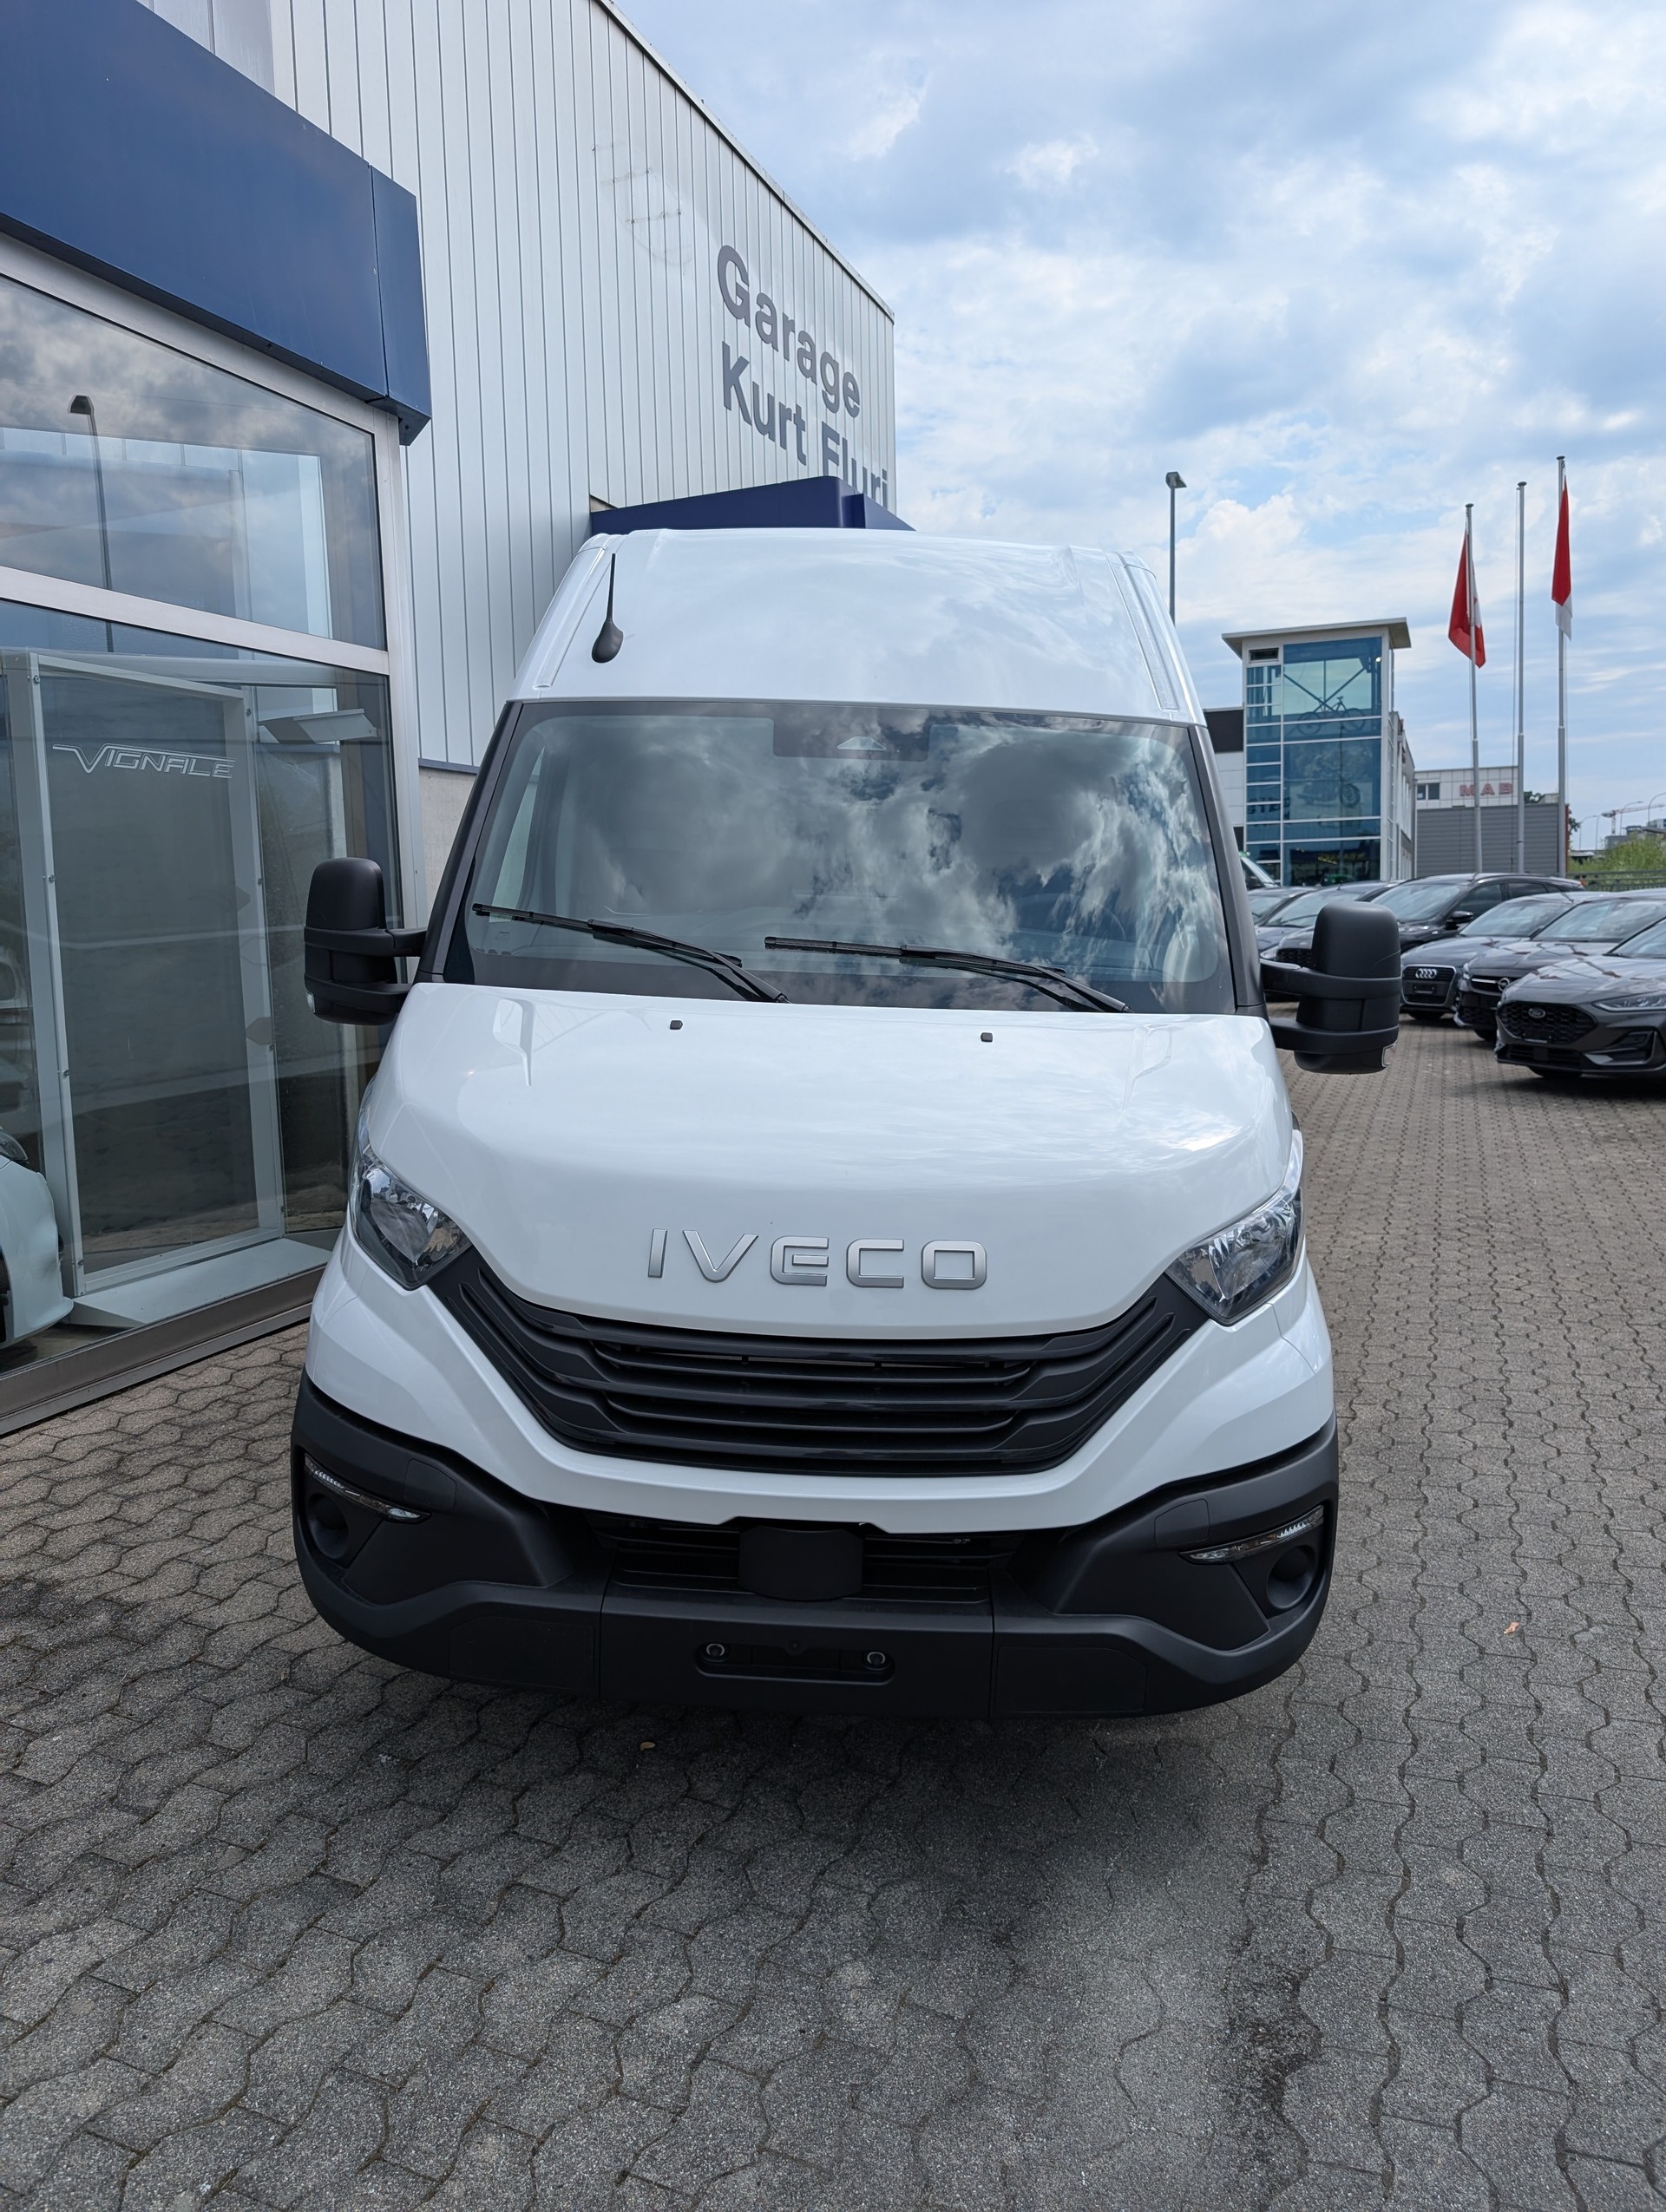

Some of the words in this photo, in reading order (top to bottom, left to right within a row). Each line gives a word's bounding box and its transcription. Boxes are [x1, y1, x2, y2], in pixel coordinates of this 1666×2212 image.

[718, 245, 860, 418] Garage
[722, 341, 806, 466] Kurt
[52, 743, 236, 779] VIGNALE
[647, 1228, 987, 1290] IVECO
